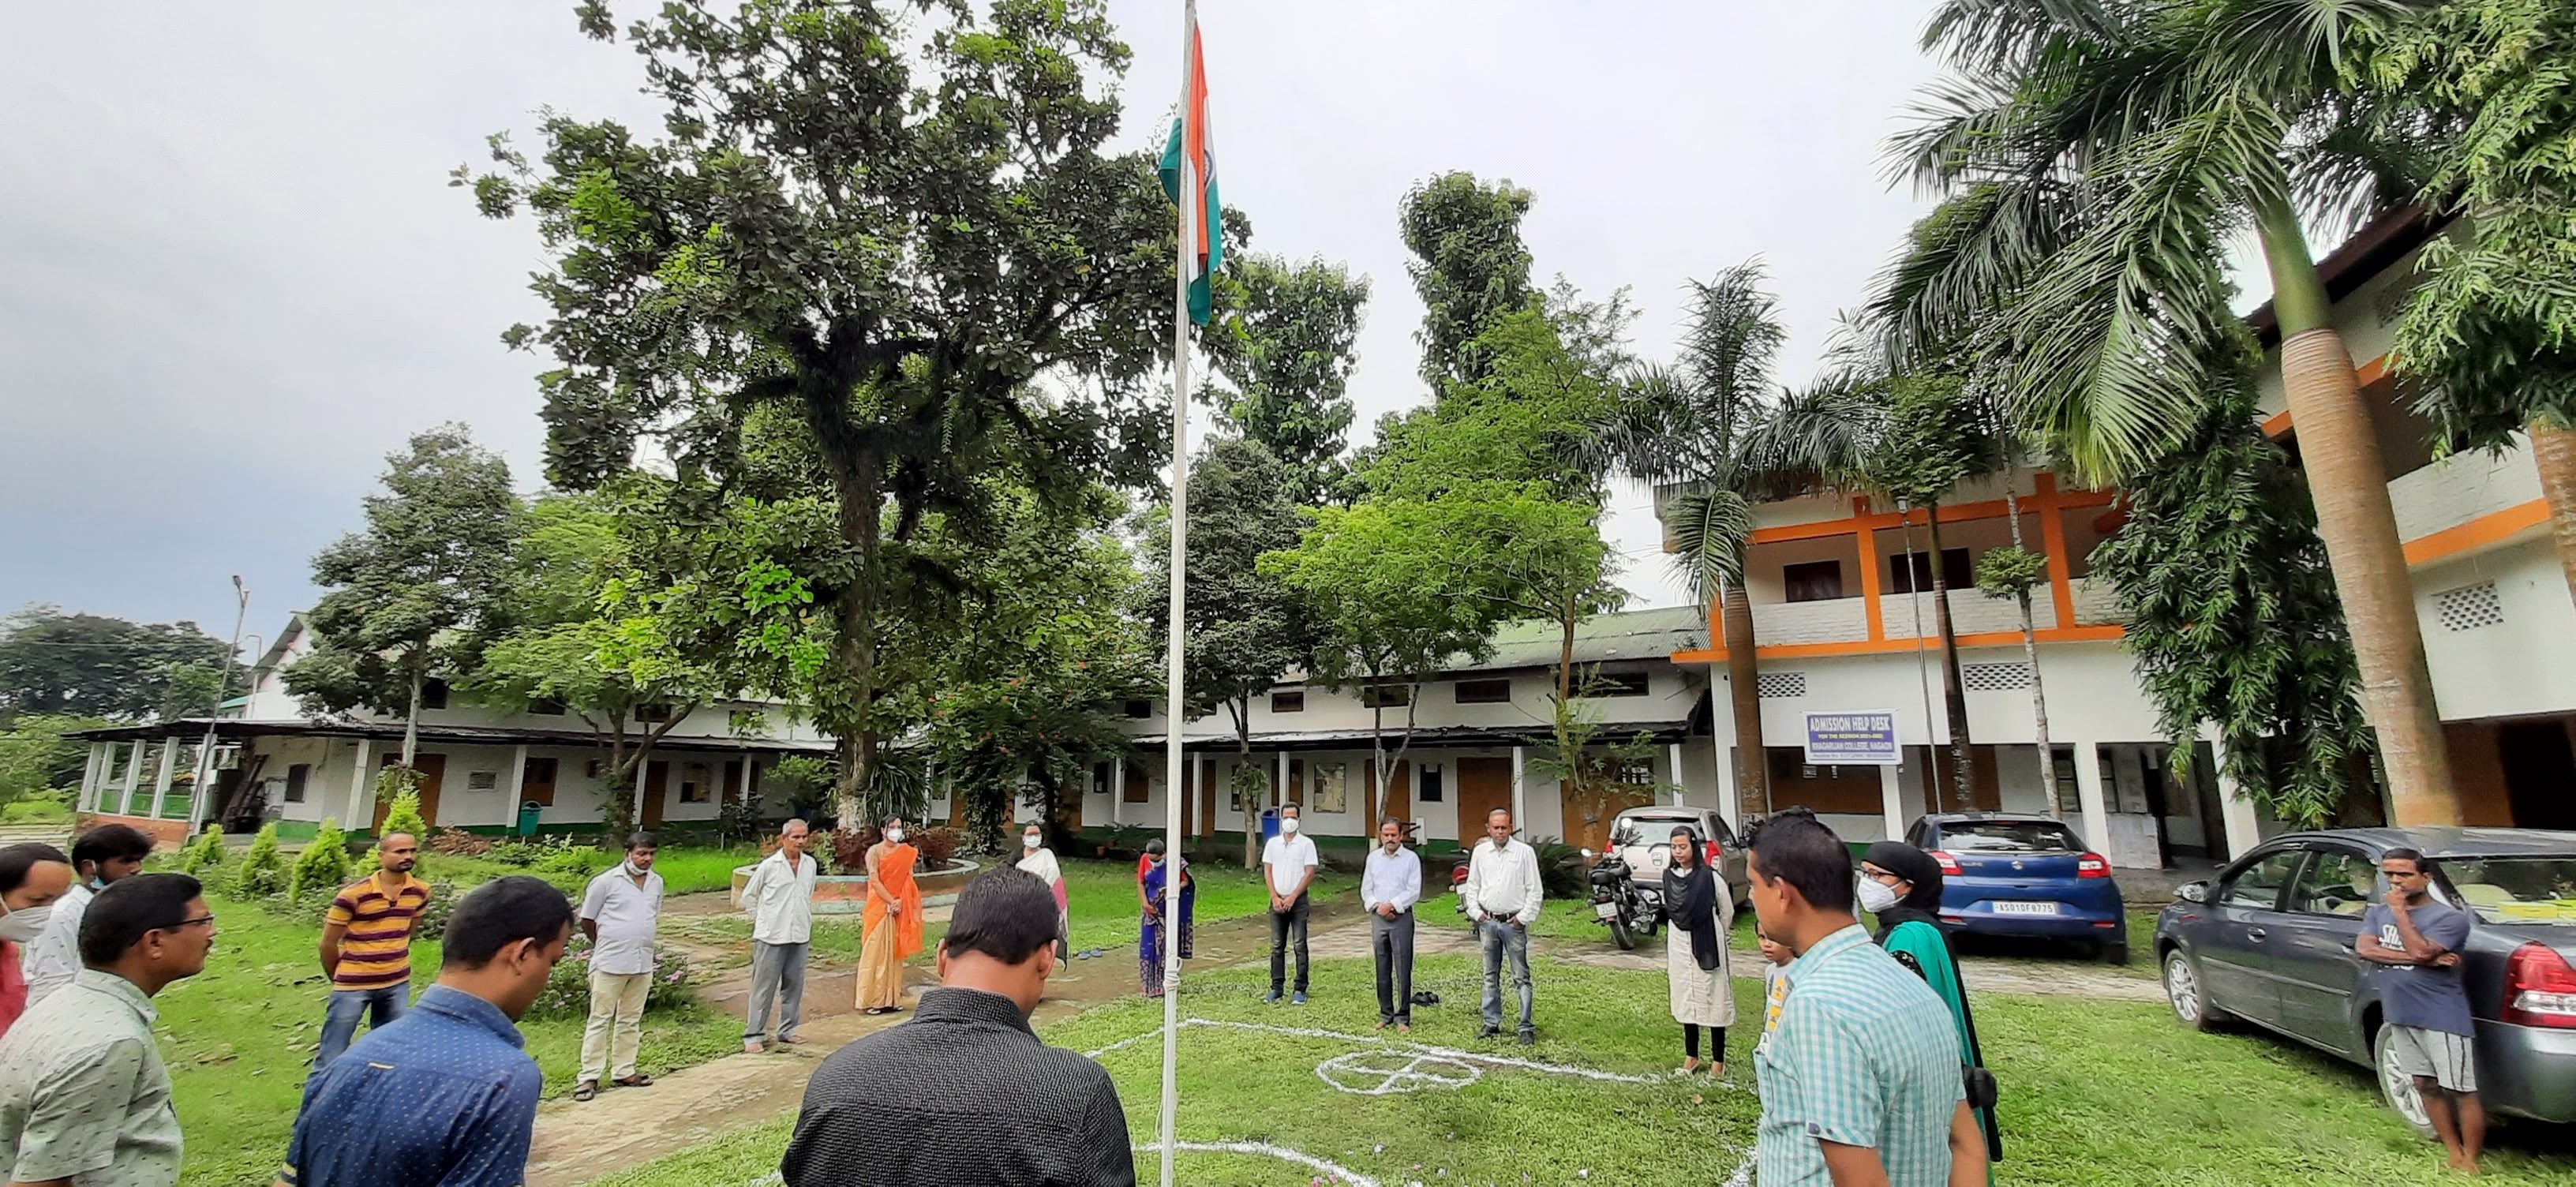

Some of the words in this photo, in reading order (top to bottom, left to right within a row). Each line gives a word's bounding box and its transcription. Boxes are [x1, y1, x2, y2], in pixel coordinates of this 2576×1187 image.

[1810, 717, 1852, 732] ADMISSION
[1852, 717, 1870, 731] HELP
[1870, 716, 1891, 731] DESK
